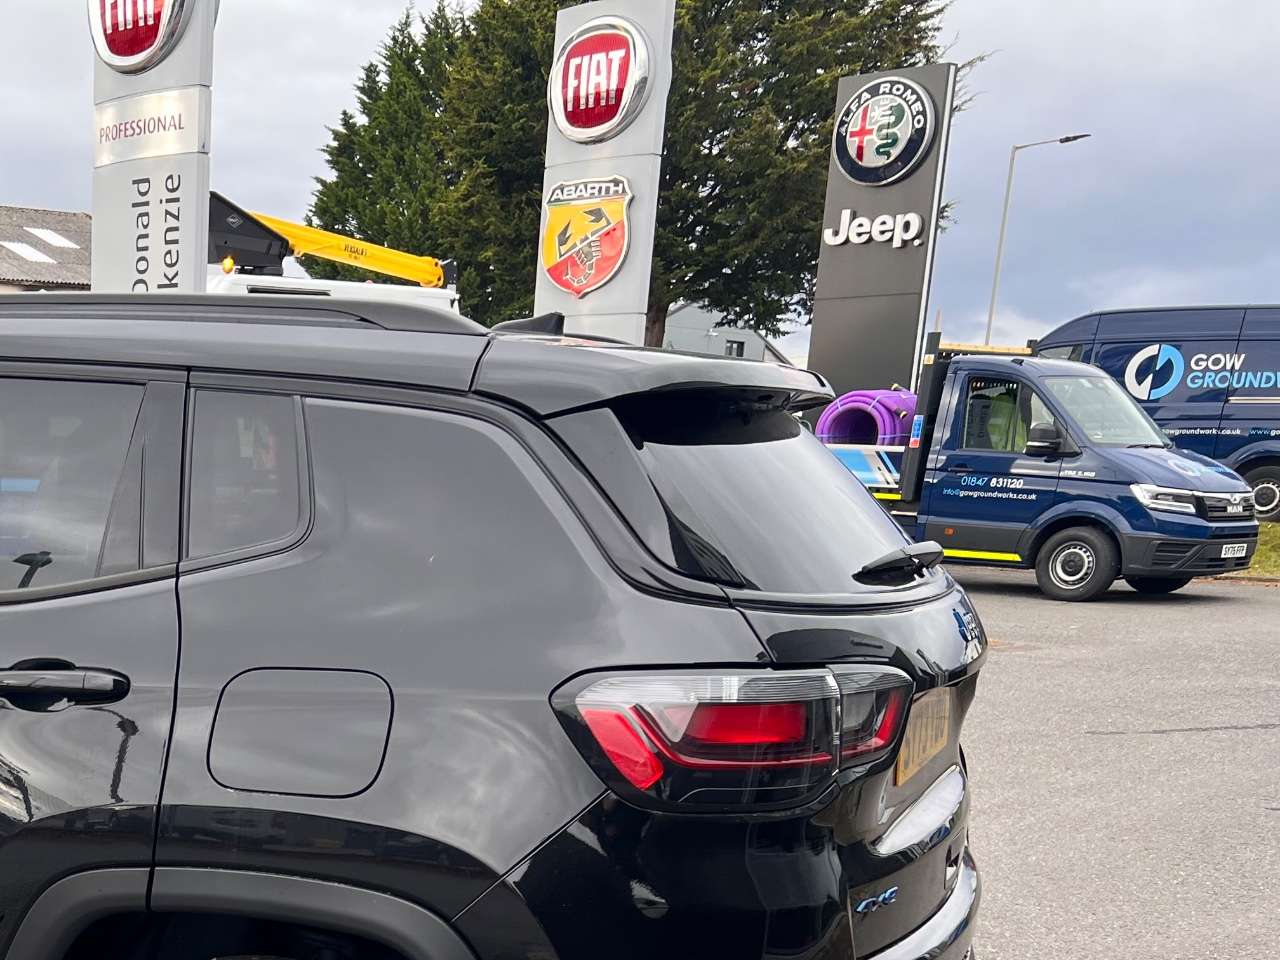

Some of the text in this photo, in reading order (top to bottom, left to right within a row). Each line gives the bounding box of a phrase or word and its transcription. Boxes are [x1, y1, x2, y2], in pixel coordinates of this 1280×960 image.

[567, 49, 626, 112] FIAT
[839, 82, 924, 136] ALFA ROMEO
[99, 113, 184, 144] PROFESSIONAL
[552, 182, 623, 200] ABARTH
[1190, 353, 1246, 371] GOW
[961, 476, 1024, 489] 01847 831120
[942, 488, 1038, 501] info@gowgroundworks.co.uk
